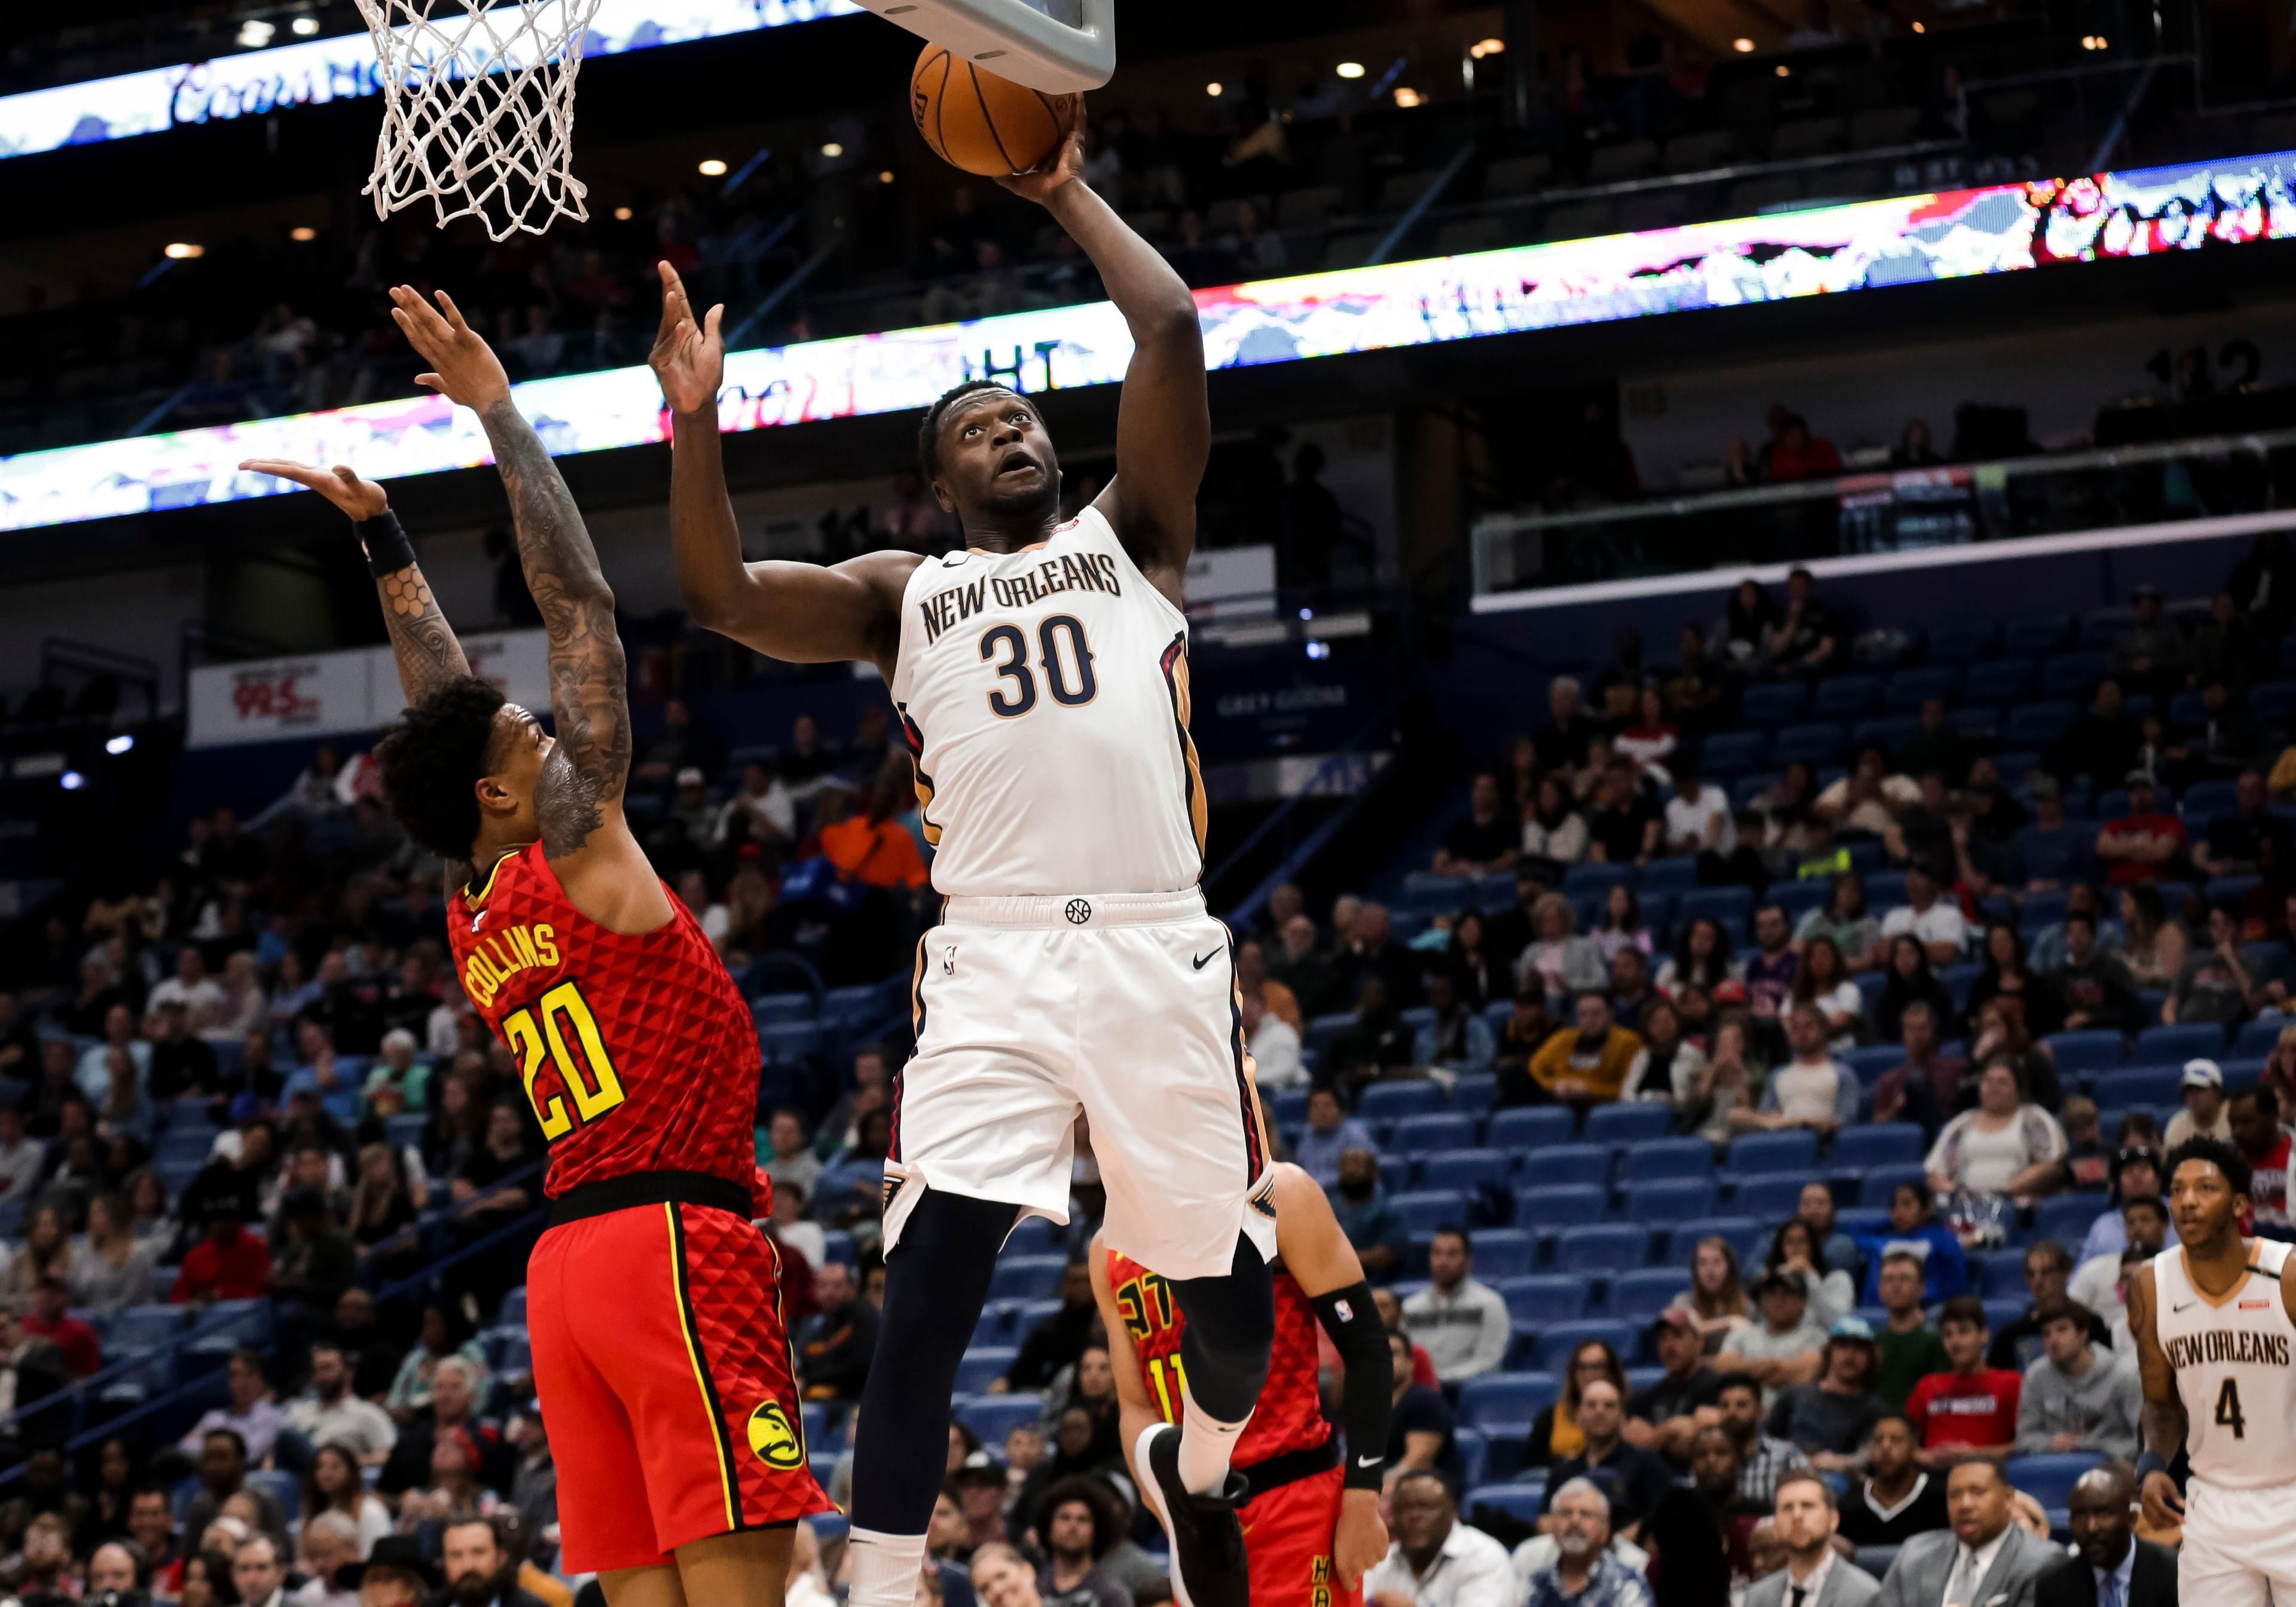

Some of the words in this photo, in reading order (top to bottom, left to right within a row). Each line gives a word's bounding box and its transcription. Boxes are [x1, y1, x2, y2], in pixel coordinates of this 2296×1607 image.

[920, 575, 987, 646] NEW
[990, 551, 1122, 608] ORLEANS
[979, 613, 1099, 719] 30
[465, 923, 560, 1008] COLLINS
[501, 980, 628, 1143] 20
[1149, 1353, 1186, 1425] 11
[2165, 1331, 2203, 1370] NEW
[2205, 1328, 2290, 1367] ORLEANS
[2214, 1376, 2246, 1440] 4
